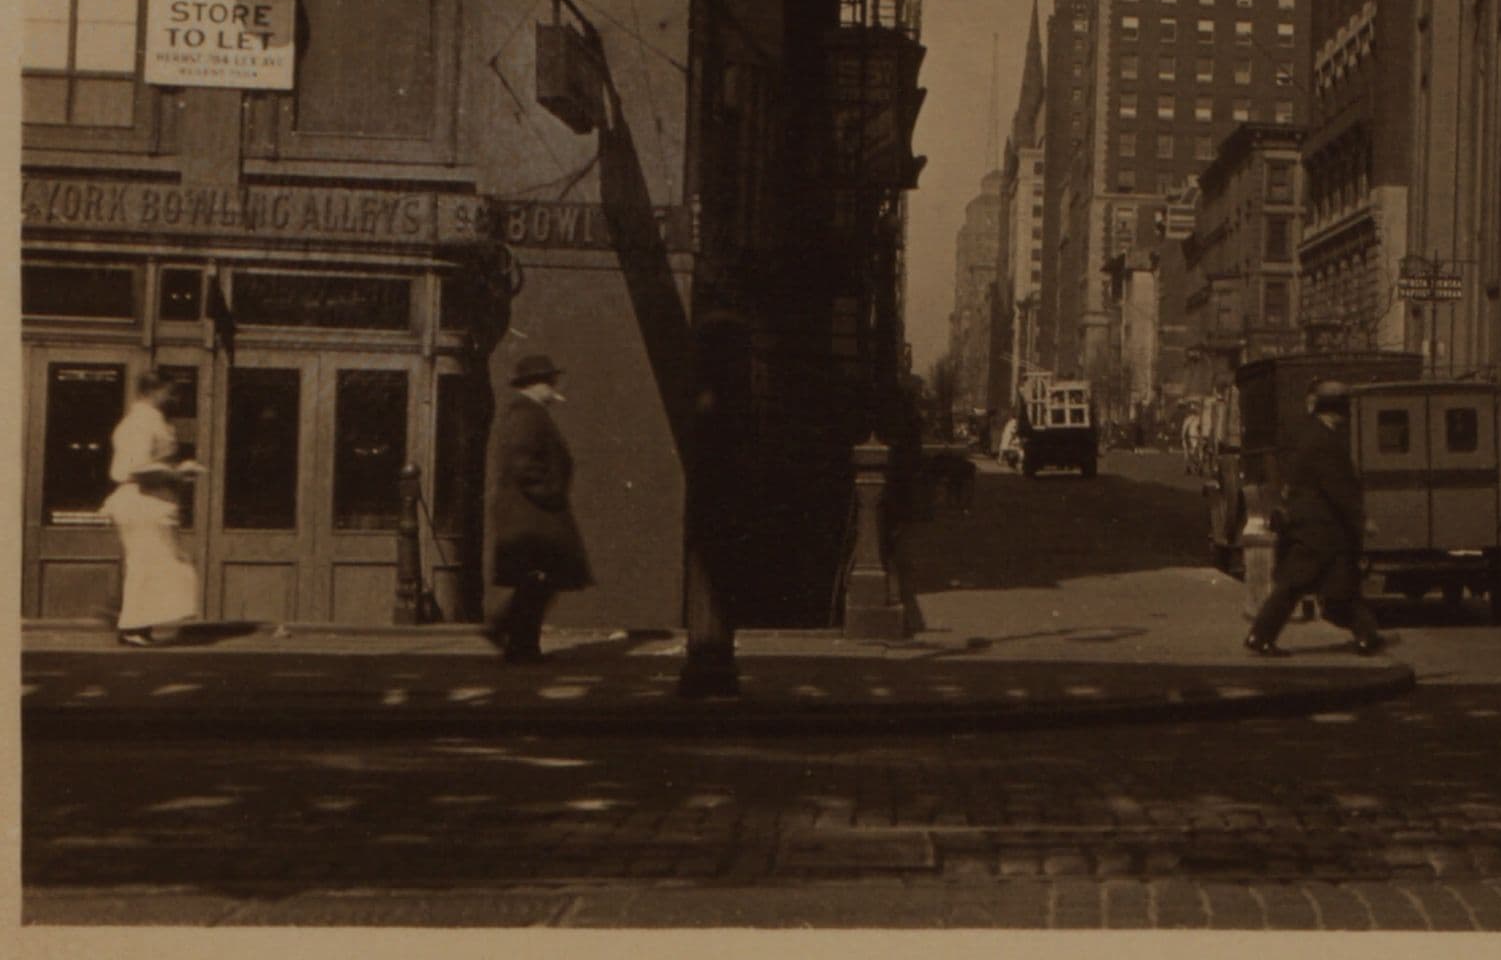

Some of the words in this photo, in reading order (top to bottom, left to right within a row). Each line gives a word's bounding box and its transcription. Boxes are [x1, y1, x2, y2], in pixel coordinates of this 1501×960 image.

[169, 0, 273, 27] STORE
[164, 27, 205, 48] TO
[217, 30, 276, 51] LET
[42, 183, 128, 224] YORK
[141, 186, 290, 230] BOWLING
[302, 193, 420, 234] ALLEYS
